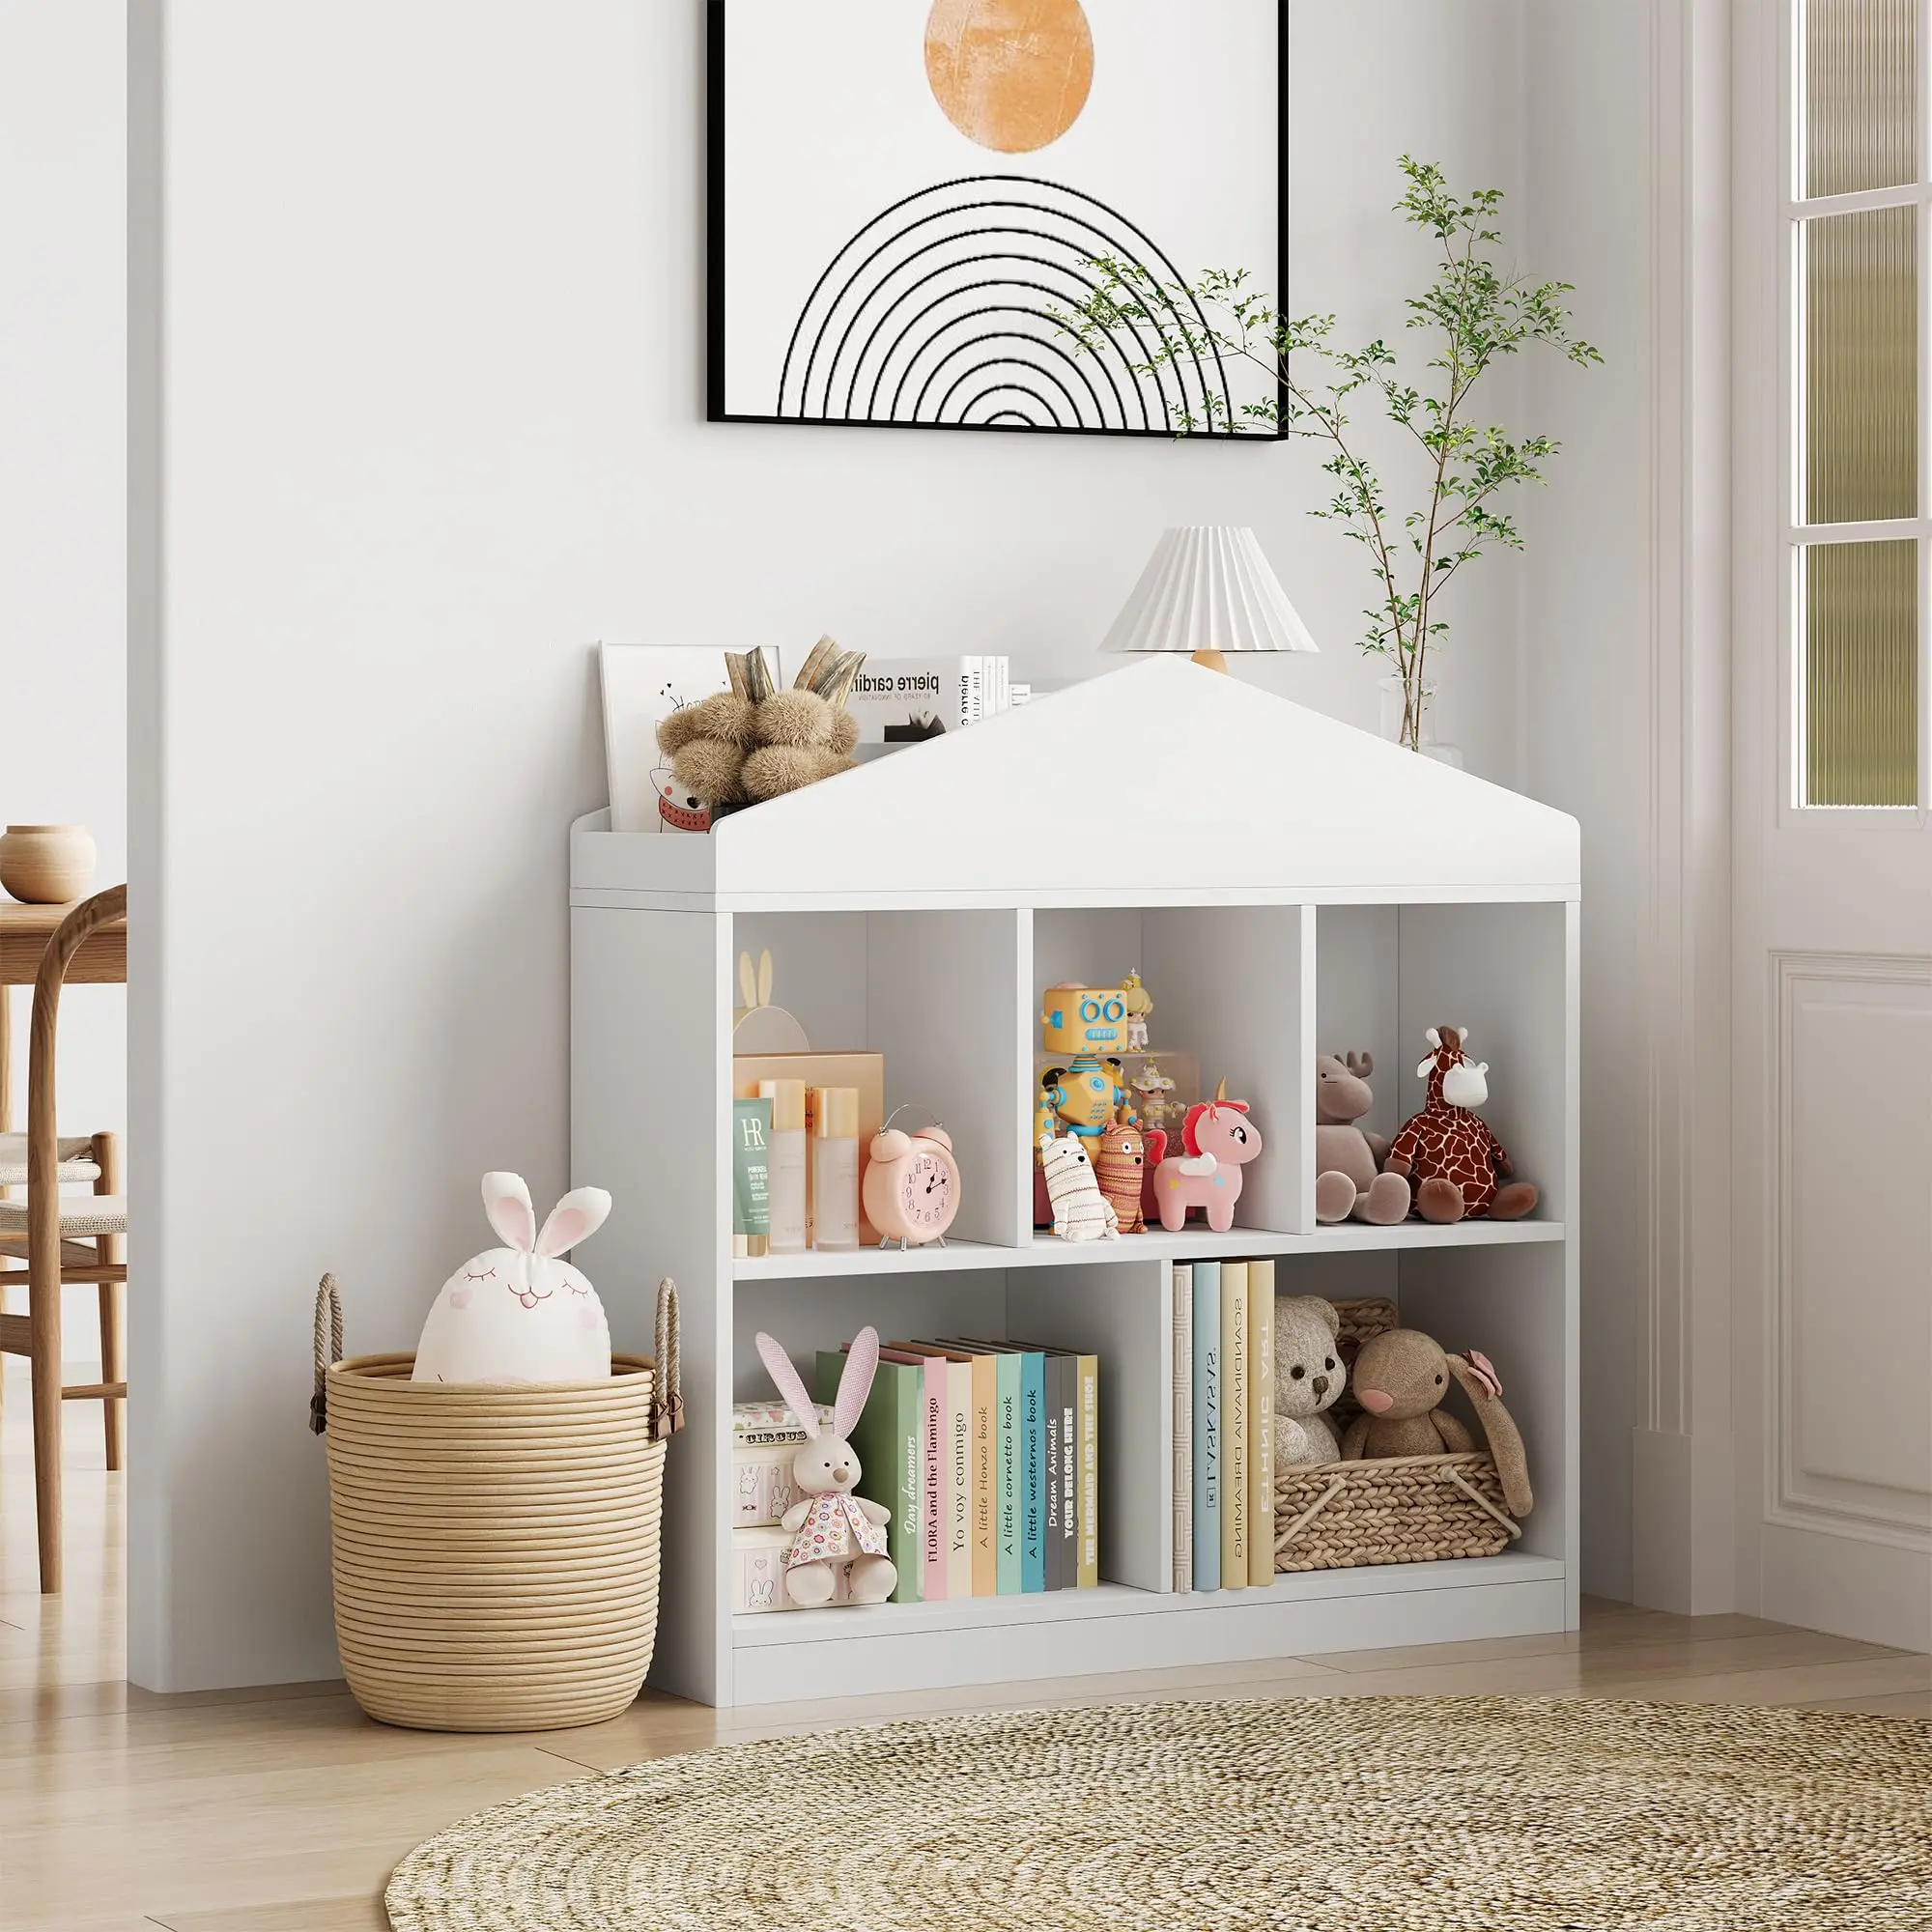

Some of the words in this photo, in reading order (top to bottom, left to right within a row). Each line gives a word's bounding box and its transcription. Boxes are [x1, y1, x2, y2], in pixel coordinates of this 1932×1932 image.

[740, 1118, 765, 1147] HR
[908, 1174, 917, 1183] 10
[923, 1159, 932, 1169] 12
[906, 1187, 913, 1198] 9
[908, 1200, 916, 1210] 8
[925, 1211, 931, 1222] 6
[1003, 1396, 1012, 1430] book
[1027, 1389, 1036, 1422] book
[746, 1431, 808, 1444] CIRCUS
[927, 1398, 940, 1461] Flamingo
[978, 1406, 987, 1439] book
[1064, 1407, 1073, 1443] HERE
[953, 1412, 967, 1486] conmigo
[1047, 1418, 1057, 1475] Animals
[901, 1435, 917, 1499] dreamers
[927, 1464, 938, 1487] the
[1004, 1435, 1012, 1497] cornetto
[1028, 1429, 1037, 1501] westernos
[1064, 1445, 1074, 1497] BELONG
[927, 1491, 938, 1517] and
[955, 1493, 967, 1522] voy
[979, 1496, 988, 1530] little
[1048, 1480, 1058, 1526] Dream
[1064, 1499, 1074, 1539] YOUR
[904, 1505, 919, 1535] Day
[1004, 1503, 1012, 1537] little
[1027, 1507, 1037, 1540] little
[927, 1519, 938, 1563] FLORA
[952, 1529, 965, 1551] Yo
[980, 1537, 988, 1548] A
[1005, 1544, 1012, 1555] A
[1029, 1547, 1037, 1558] A
